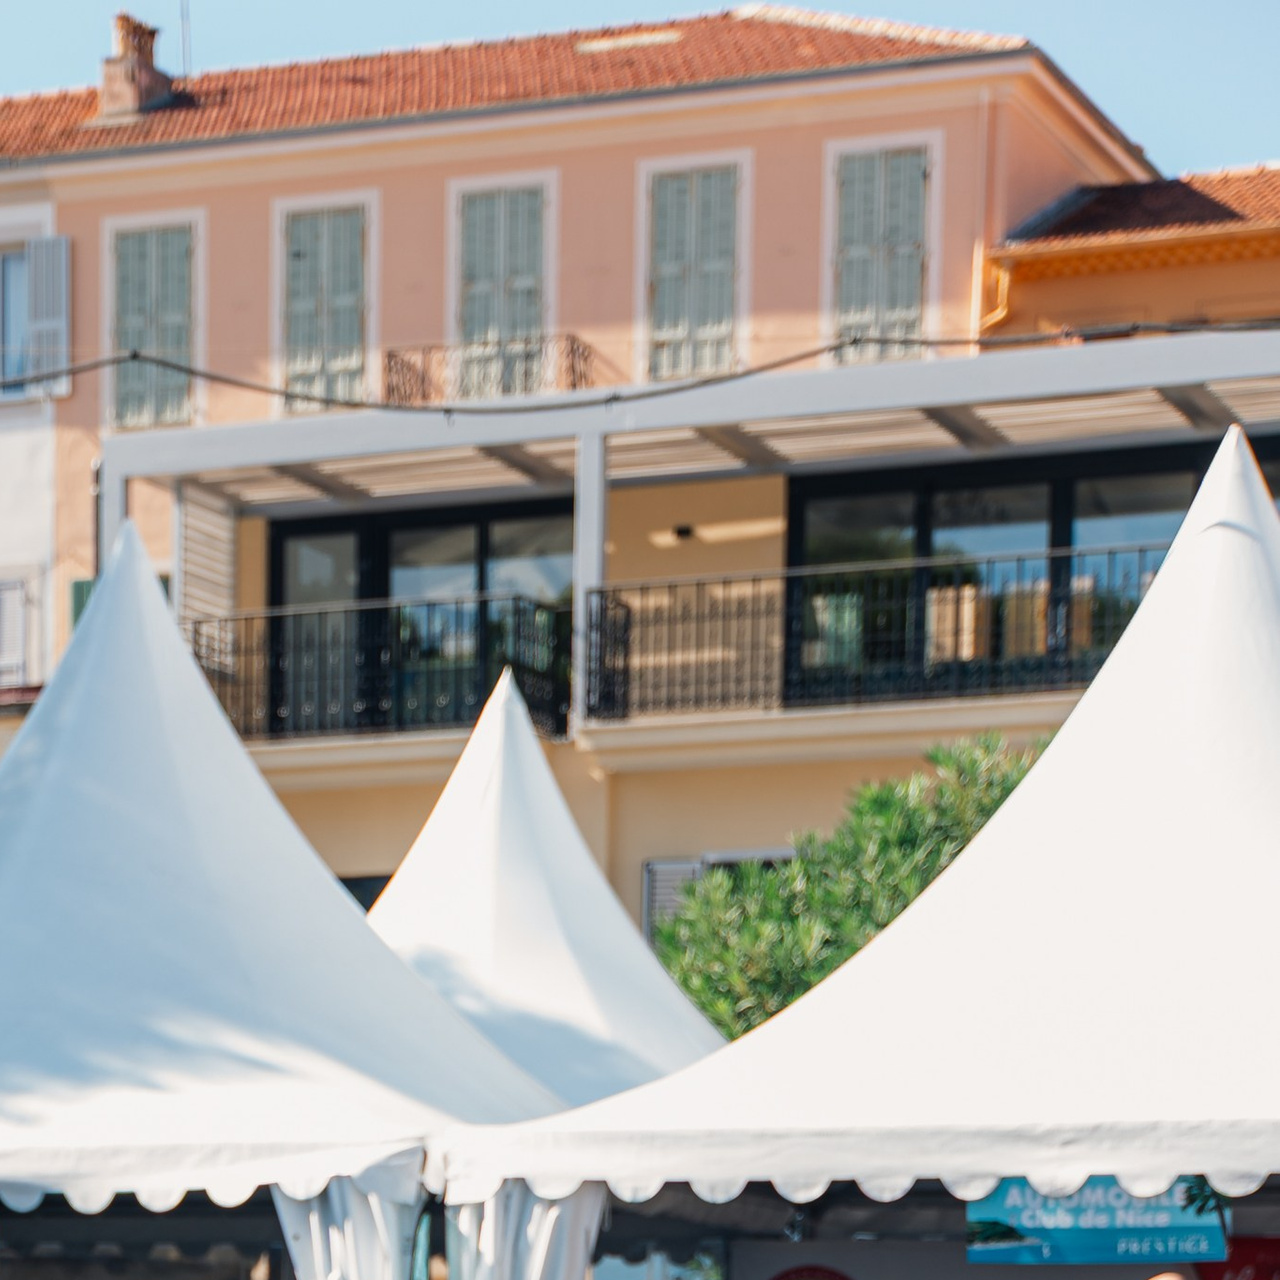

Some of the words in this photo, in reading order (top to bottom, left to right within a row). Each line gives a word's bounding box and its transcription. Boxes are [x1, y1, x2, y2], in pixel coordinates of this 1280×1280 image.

[1020, 1209, 1075, 1229] Club
[1078, 1210, 1110, 1229] de
[1115, 1210, 1172, 1228] Nice
[1116, 1239, 1210, 1255] PRESTIGE
